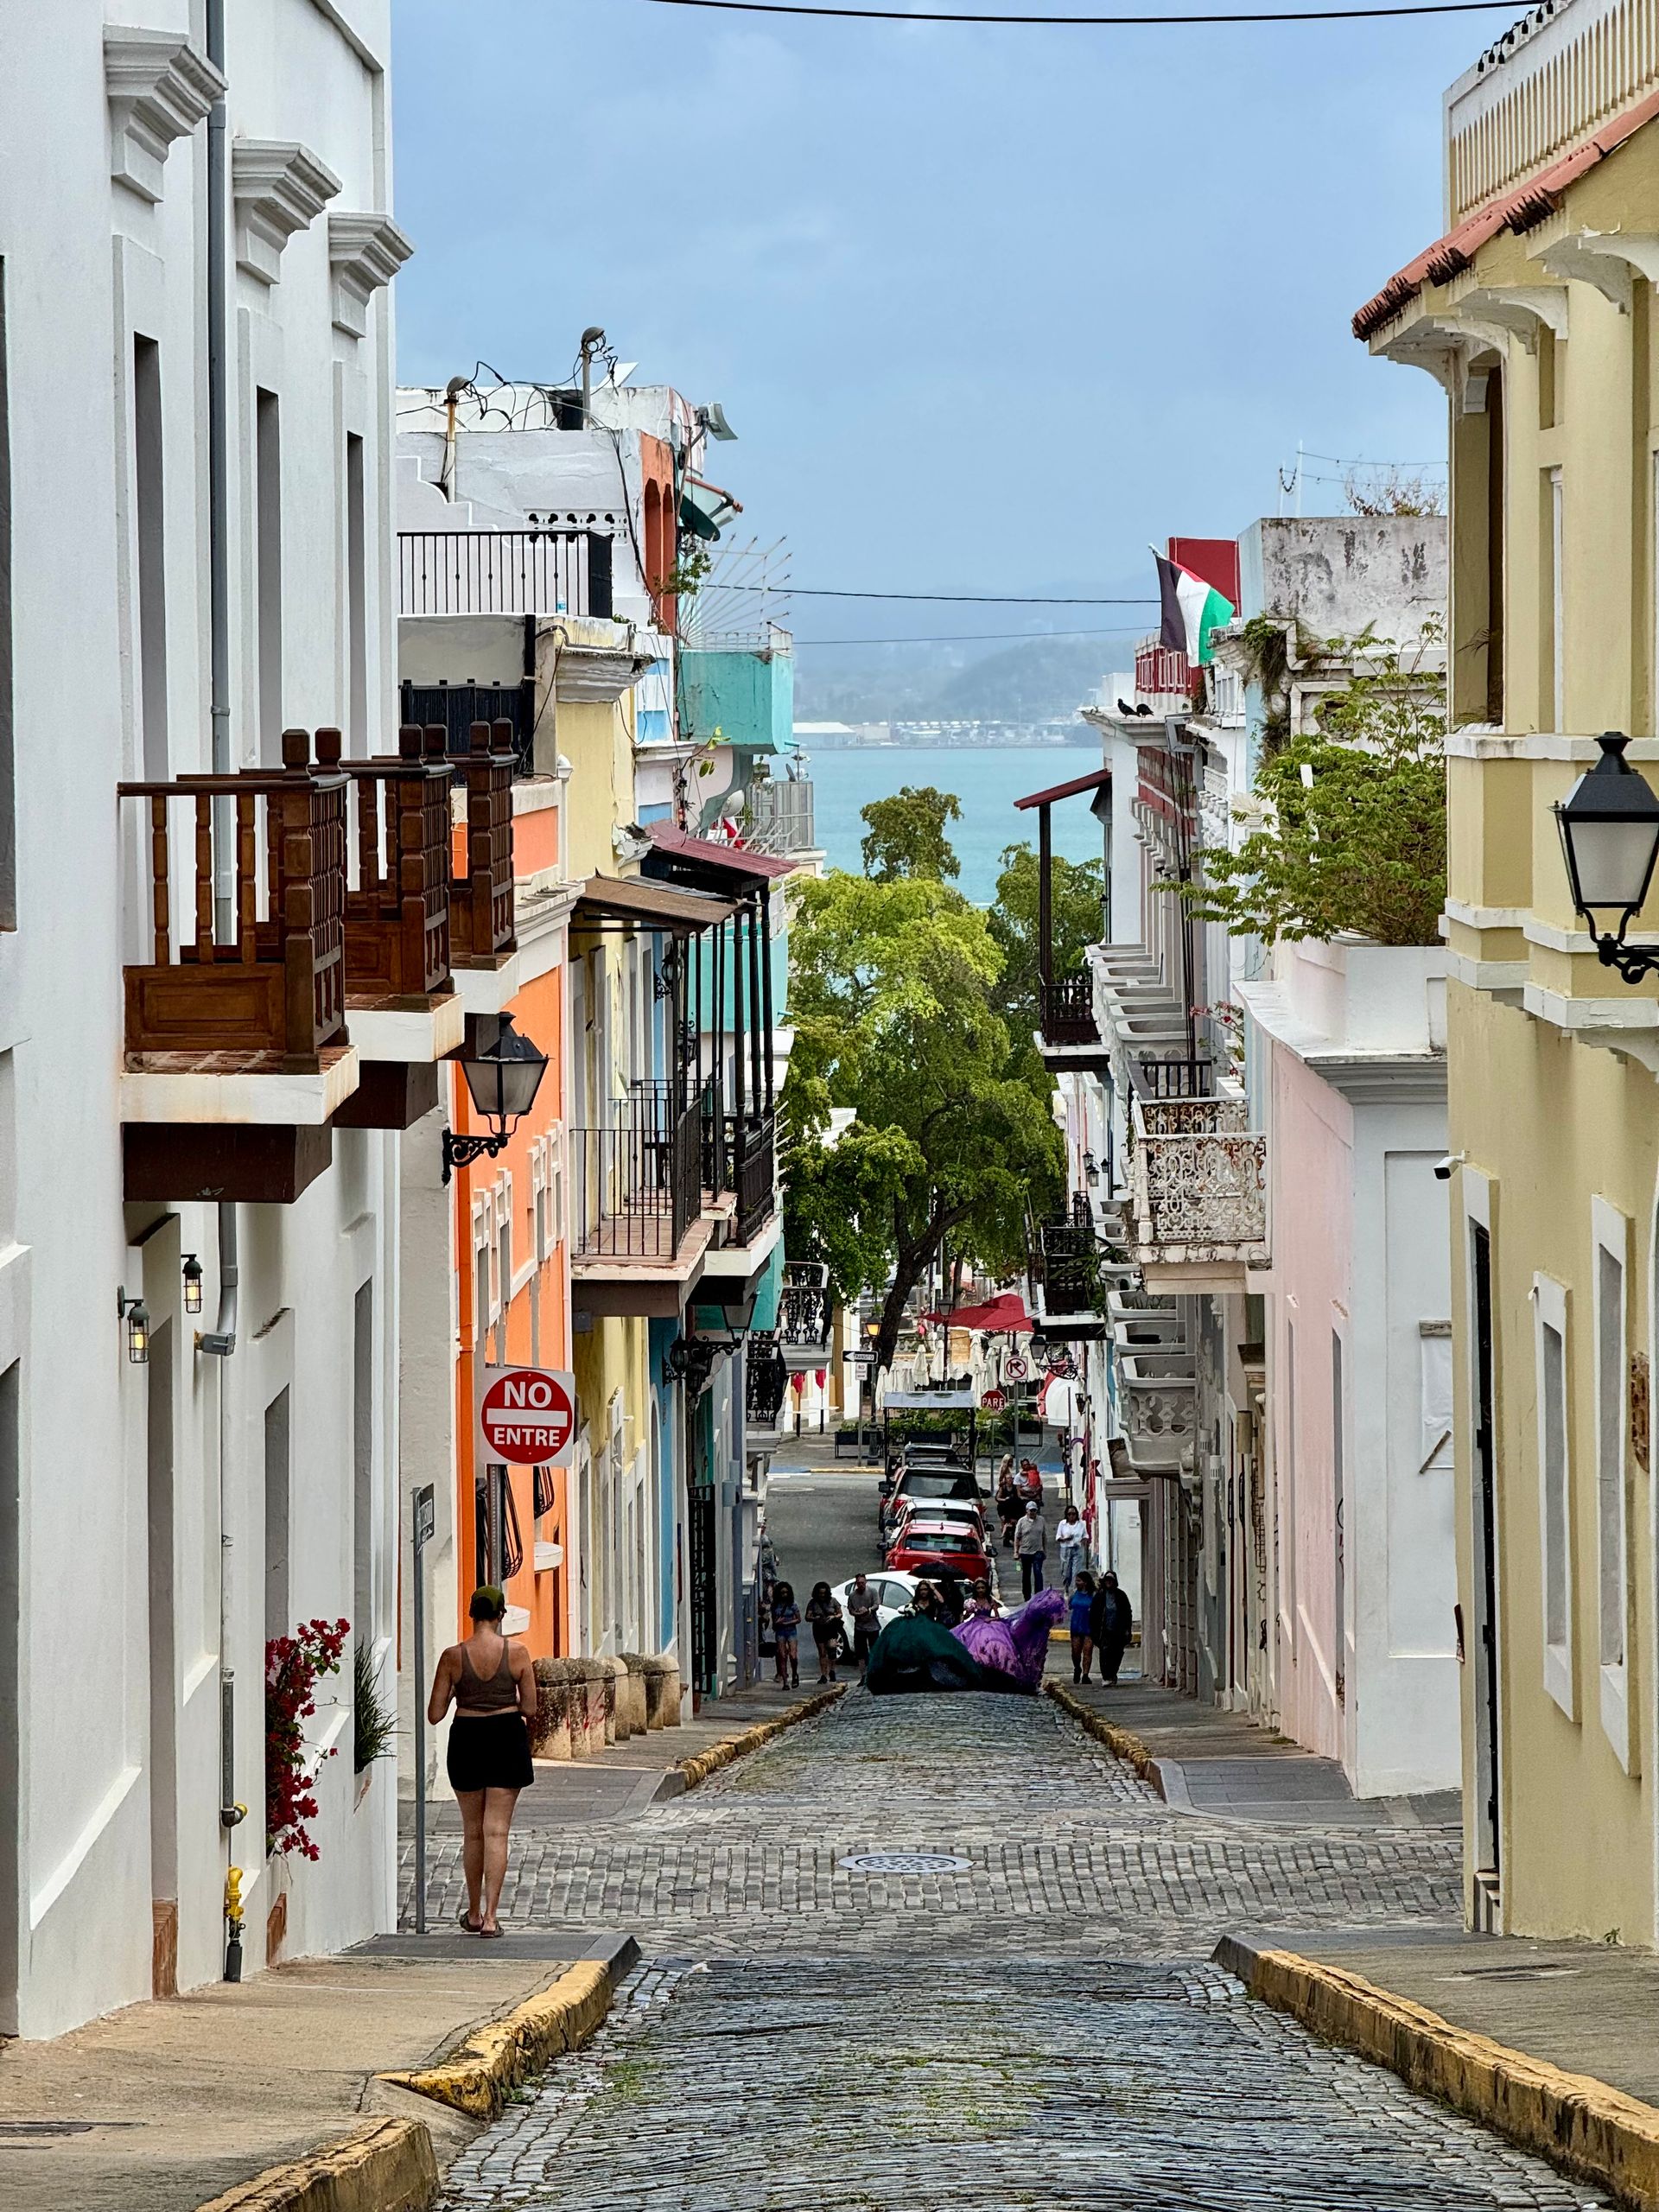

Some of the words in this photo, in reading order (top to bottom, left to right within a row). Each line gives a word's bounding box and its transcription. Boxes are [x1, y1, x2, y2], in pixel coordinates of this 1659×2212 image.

[504, 1381, 552, 1408] NO
[982, 1397, 1004, 1408] PARE
[493, 1427, 560, 1447] ENTRE
